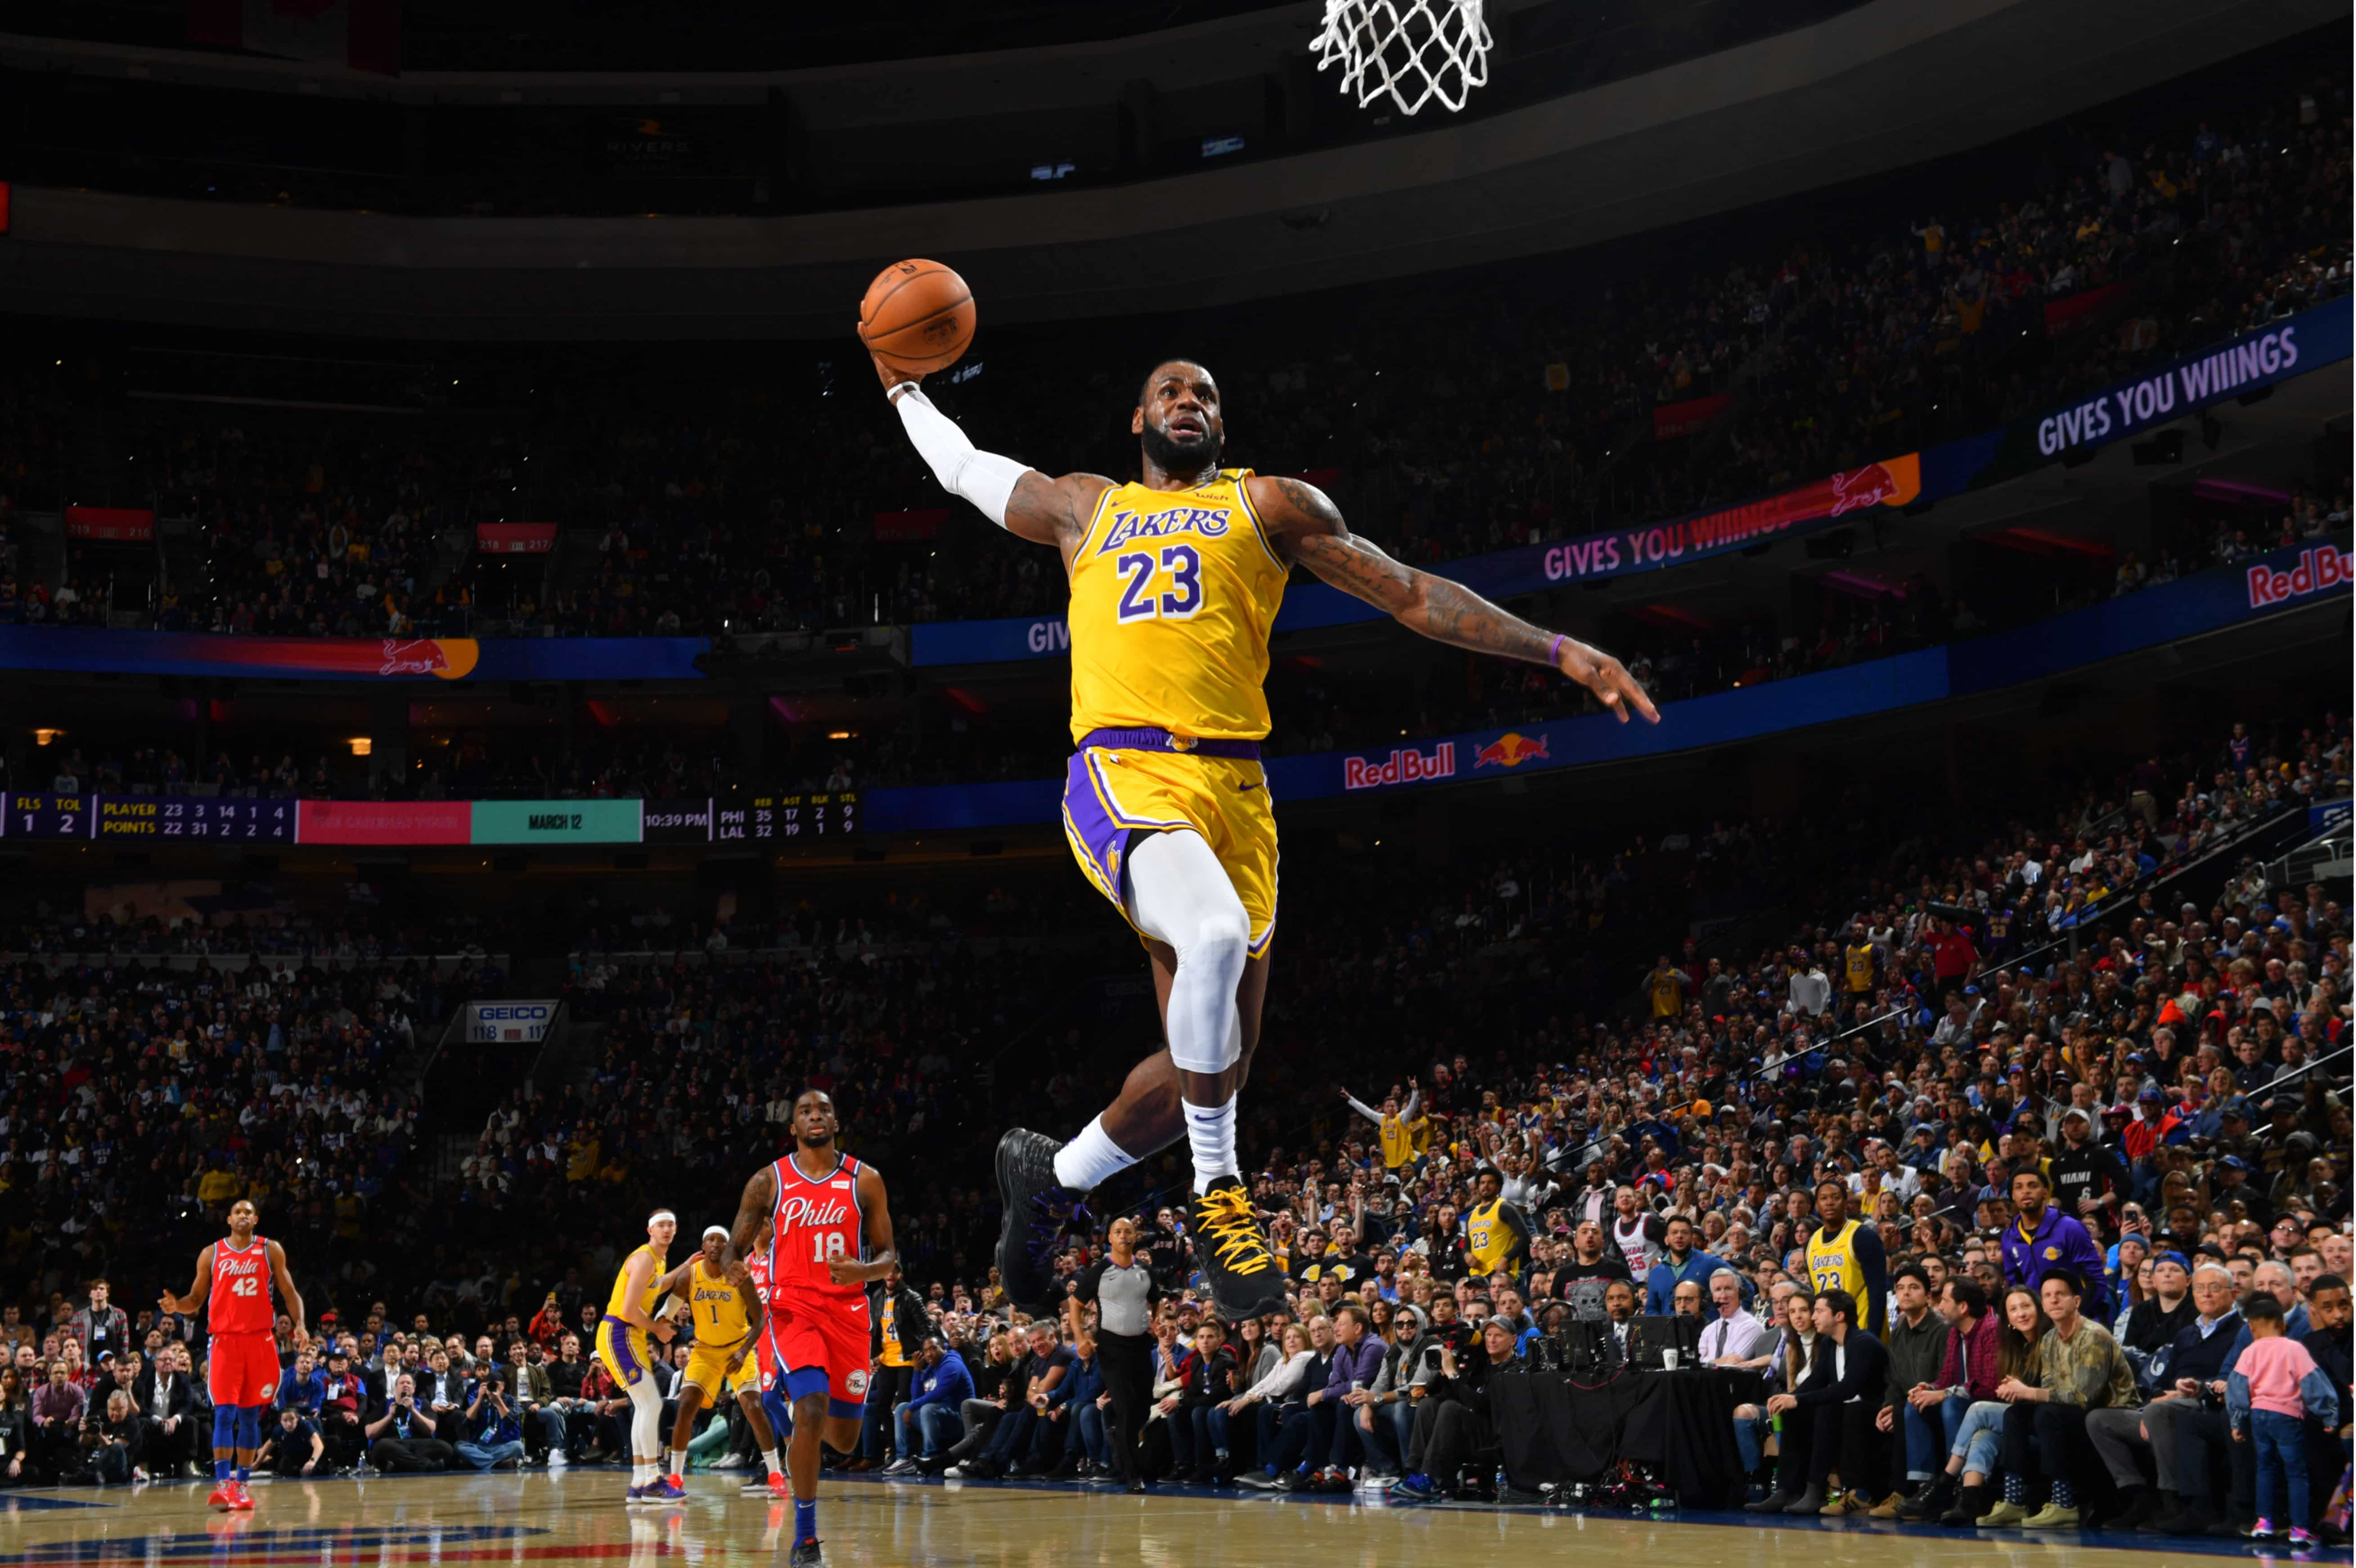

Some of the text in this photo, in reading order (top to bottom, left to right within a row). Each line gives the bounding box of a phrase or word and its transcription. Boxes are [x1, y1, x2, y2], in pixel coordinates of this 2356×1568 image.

[2038, 326, 2299, 456] GIVES YOU WIIINGS
[1194, 492, 1229, 501] wish
[1094, 508, 1231, 559] LAKERS
[1544, 537, 1621, 580] GIVES
[1628, 527, 1686, 565] YOU
[1117, 543, 1203, 625] 23
[1345, 742, 1455, 789] Red Bull
[17, 796, 81, 812] FLS TOL
[840, 793, 857, 803] STL
[103, 803, 284, 820] PLAYER 23 3 14 1 4
[645, 812, 708, 827] 10:39 PM
[720, 805, 853, 823] PHI 35 17 2 9
[23, 814, 75, 833] 1 2
[103, 820, 283, 836] POINTS 22 31 2 2 4
[528, 815, 583, 830] MARCH 12
[720, 820, 853, 839] LAL 32 19 1 9
[1851, 960, 1864, 972] 23
[479, 1007, 547, 1020] GEICO
[473, 1025, 496, 1040] 118
[2060, 1171, 2091, 1185] MIAMI
[781, 1197, 848, 1235] Phila
[813, 1231, 844, 1262] 18
[1472, 1230, 1489, 1250] 23
[218, 1257, 258, 1282] Phila
[1628, 1256, 1646, 1271] 25
[1812, 1254, 1844, 1271] LAKERS
[231, 1278, 258, 1296] 42
[694, 1287, 733, 1302] LAKERS
[711, 1305, 719, 1325] 1
